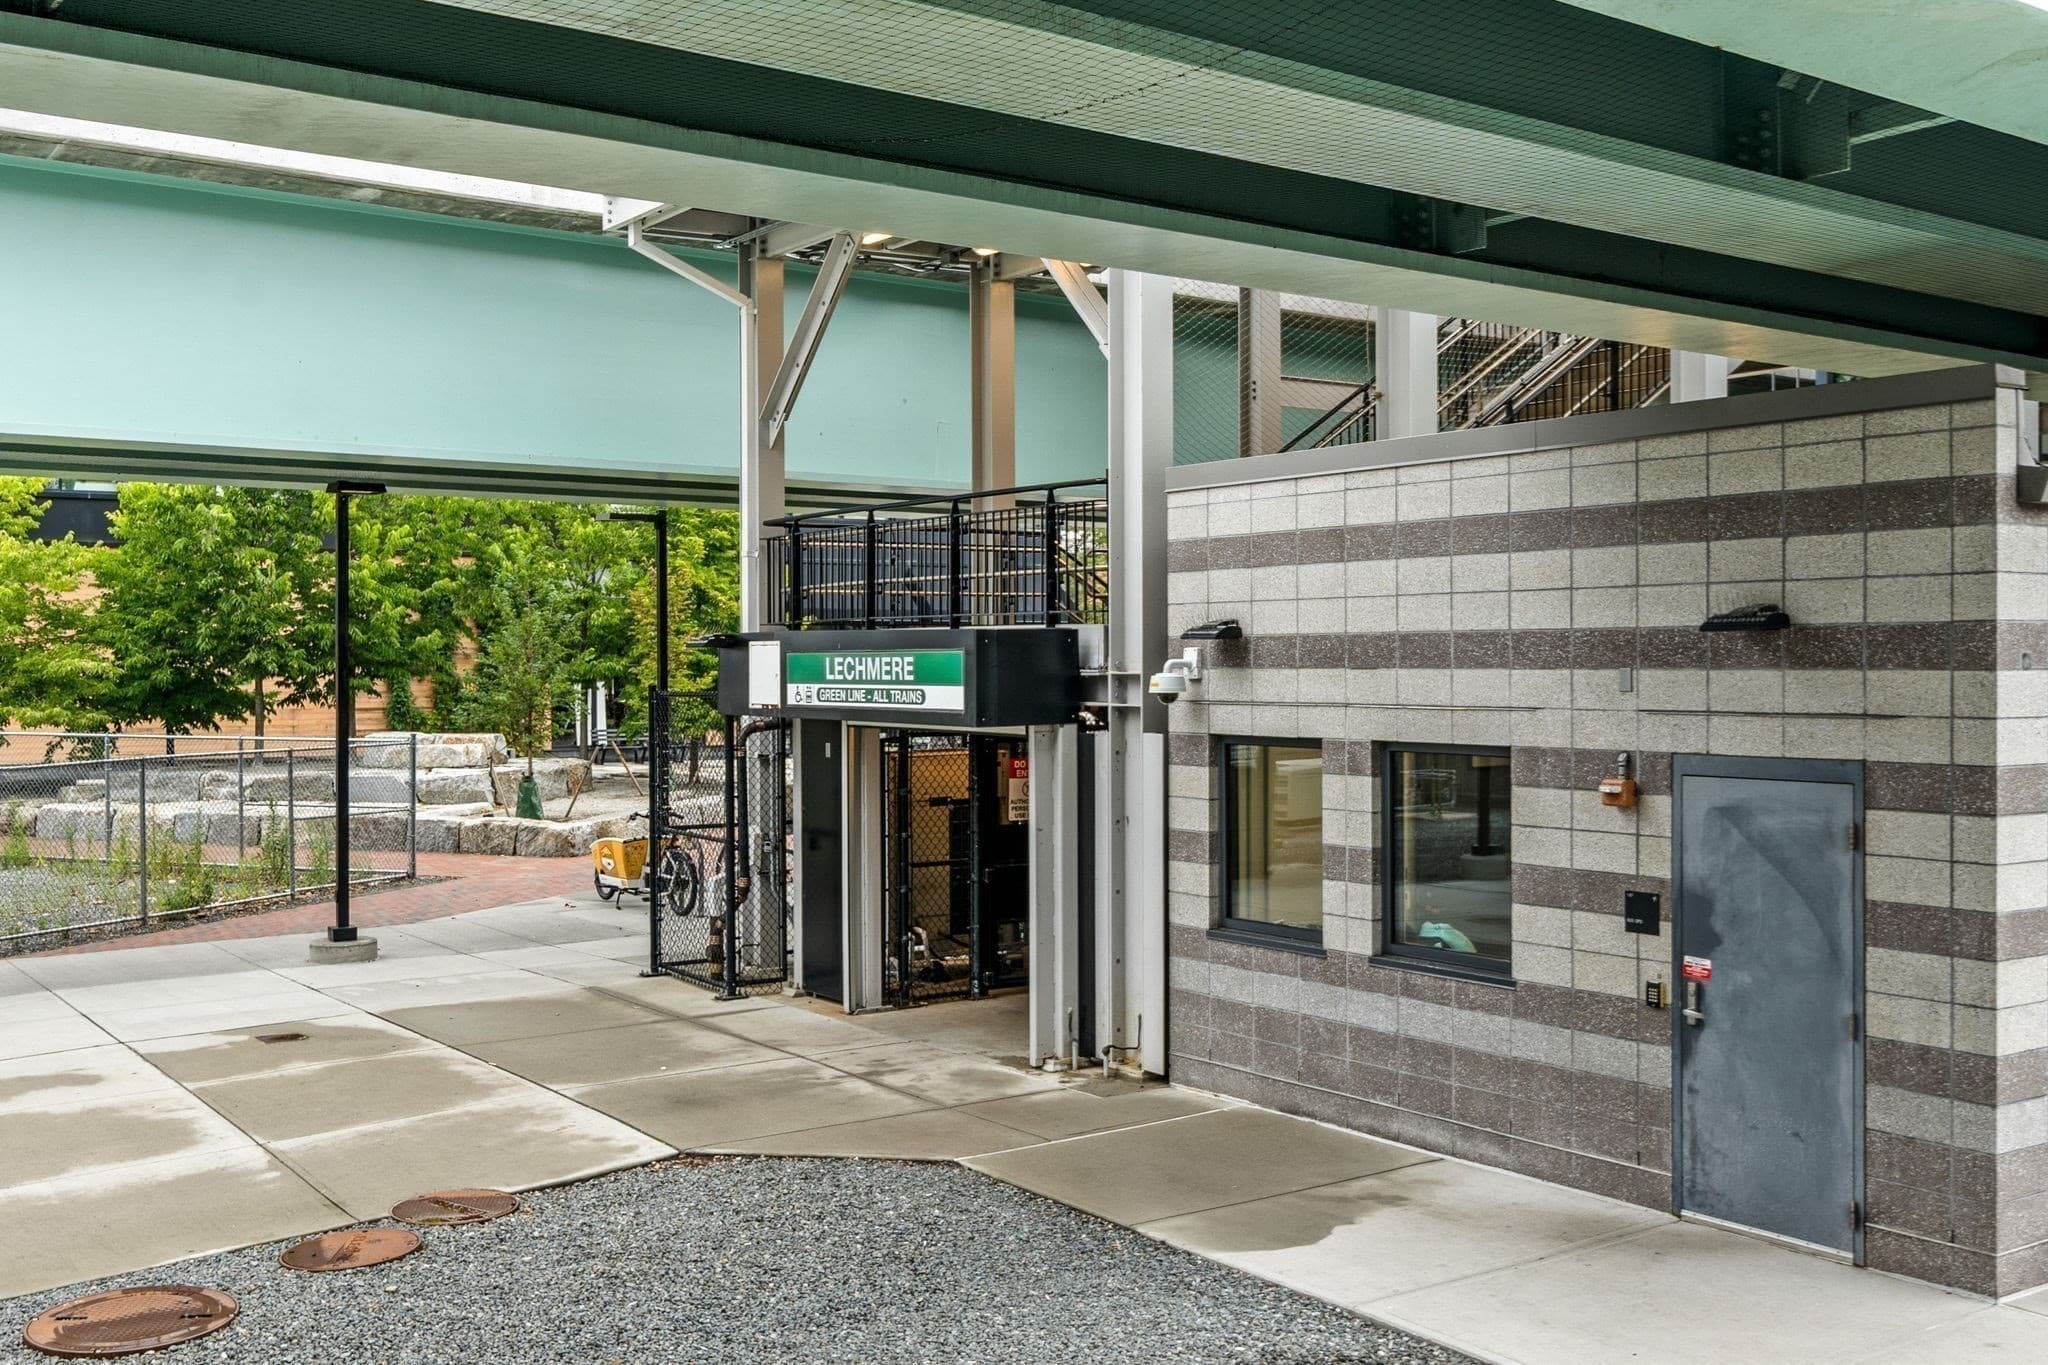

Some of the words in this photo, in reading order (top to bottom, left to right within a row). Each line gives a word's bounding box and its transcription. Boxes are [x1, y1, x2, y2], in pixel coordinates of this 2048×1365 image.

[826, 656, 915, 681] LECHMERE
[819, 689, 846, 702] GREEN
[848, 690, 866, 702] LINE
[873, 690, 889, 703] ALL
[890, 690, 922, 704] TRAINS
[1014, 760, 1025, 768] DO
[1016, 769, 1028, 777] EN
